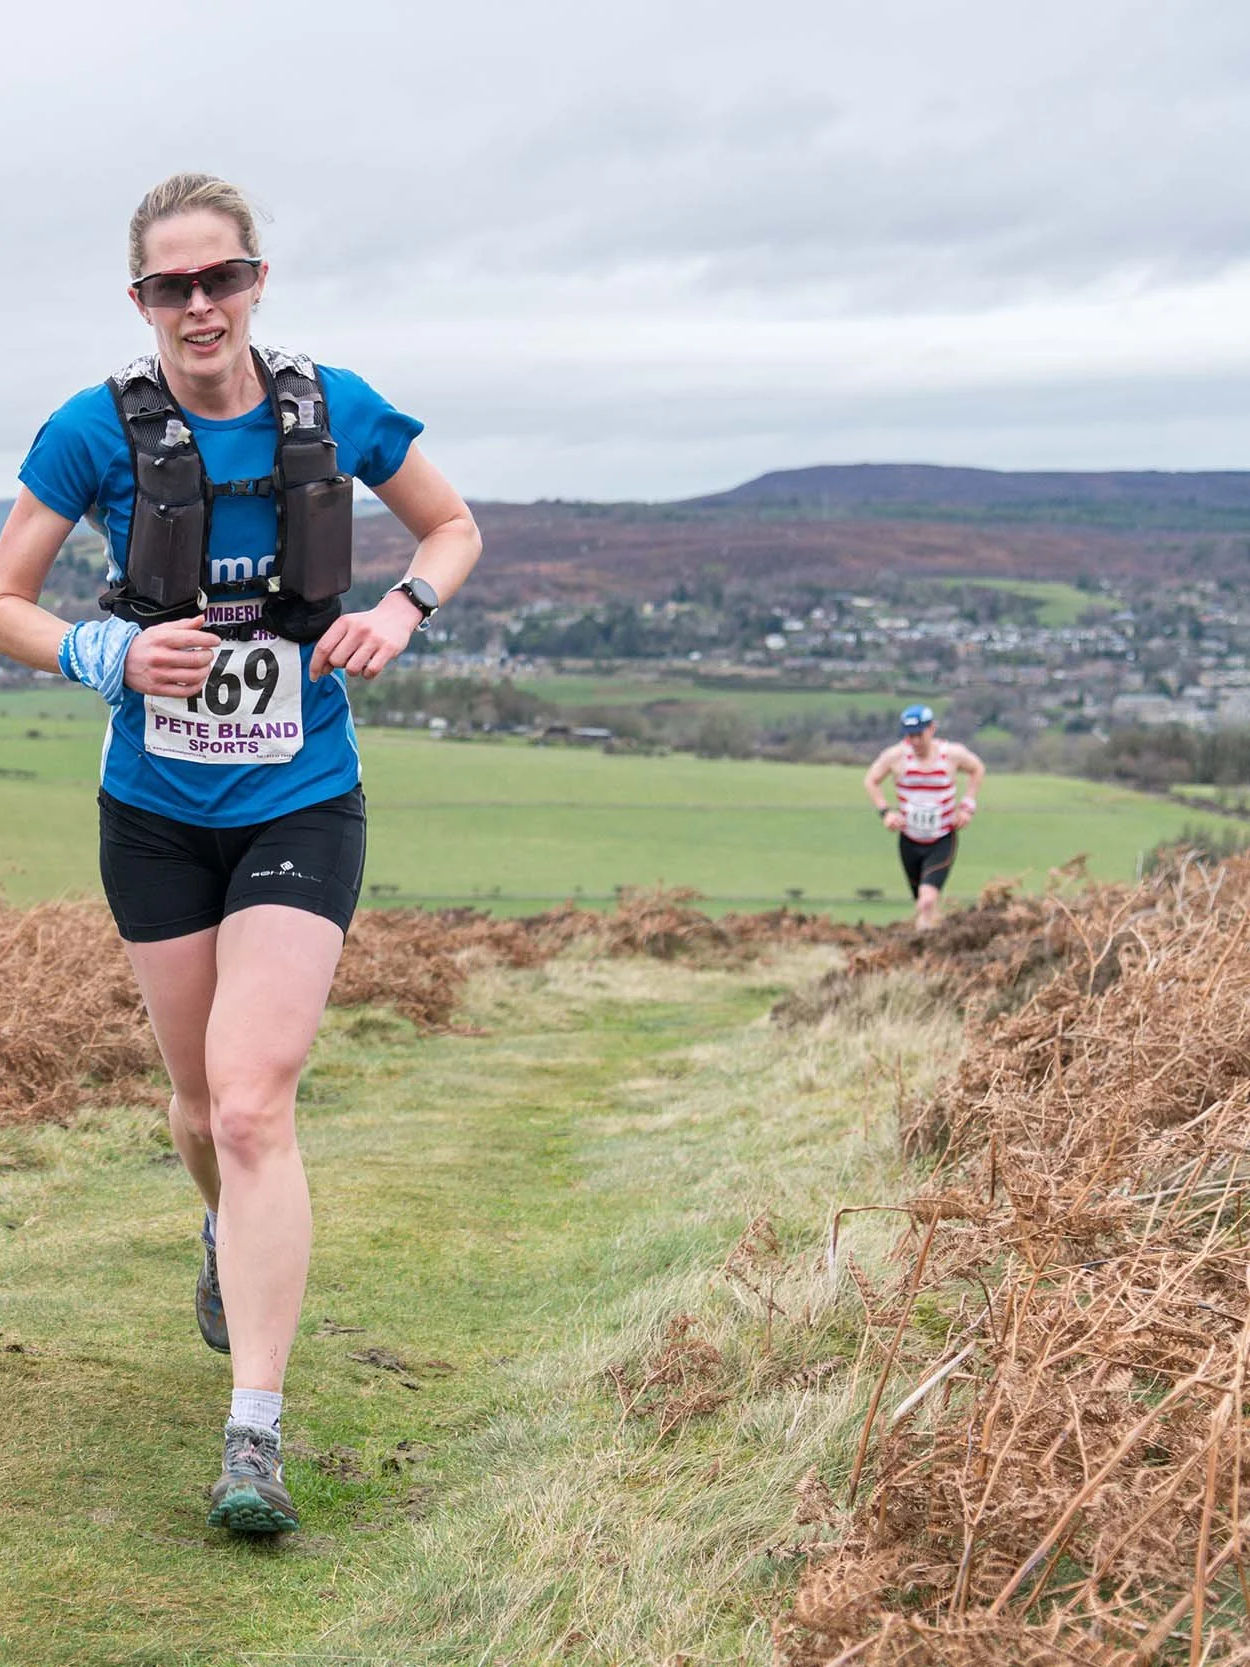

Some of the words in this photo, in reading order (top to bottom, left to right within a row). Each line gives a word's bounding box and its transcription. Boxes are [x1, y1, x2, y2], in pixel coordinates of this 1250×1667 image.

[155, 715, 209, 739] PETE
[218, 721, 298, 738] BLAND
[189, 739, 259, 754] SPORTS
